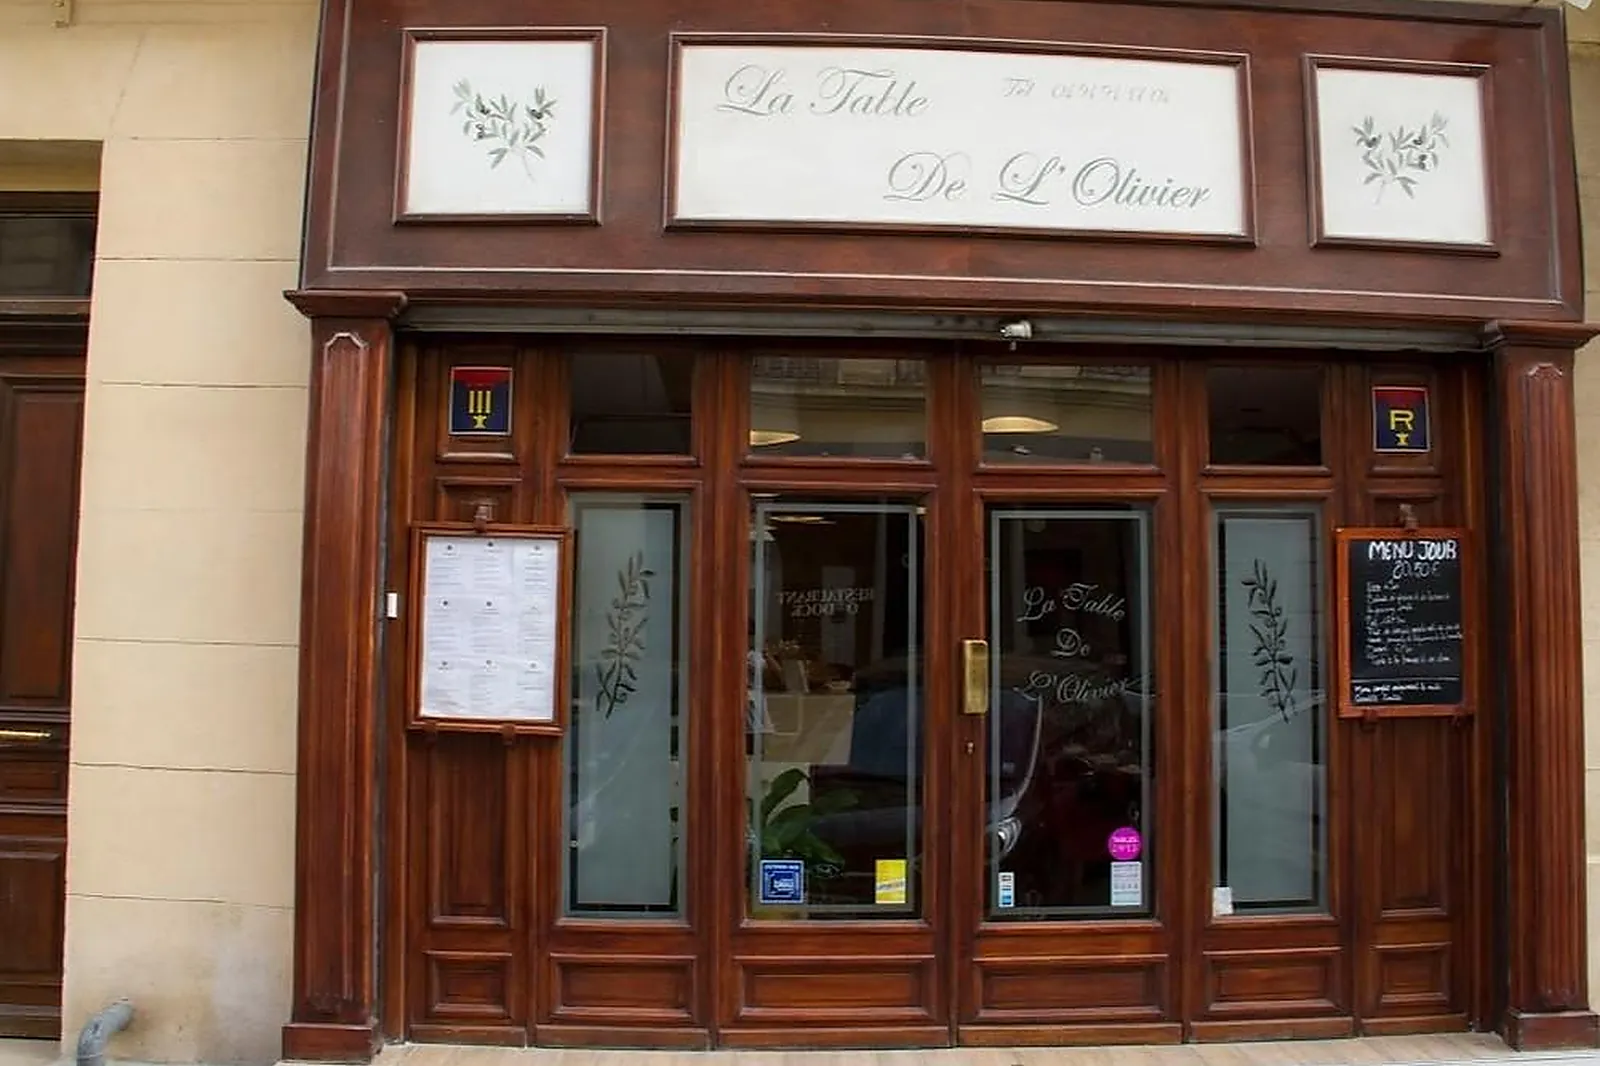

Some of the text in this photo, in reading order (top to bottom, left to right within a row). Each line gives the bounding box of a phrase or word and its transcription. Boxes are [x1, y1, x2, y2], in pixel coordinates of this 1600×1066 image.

[717, 64, 929, 116] La Table
[882, 151, 971, 201] De
[1389, 409, 1415, 431] R
[1367, 540, 1458, 561] MENU JOUR
[1016, 582, 1126, 622] La Table
[1050, 627, 1090, 657] De
